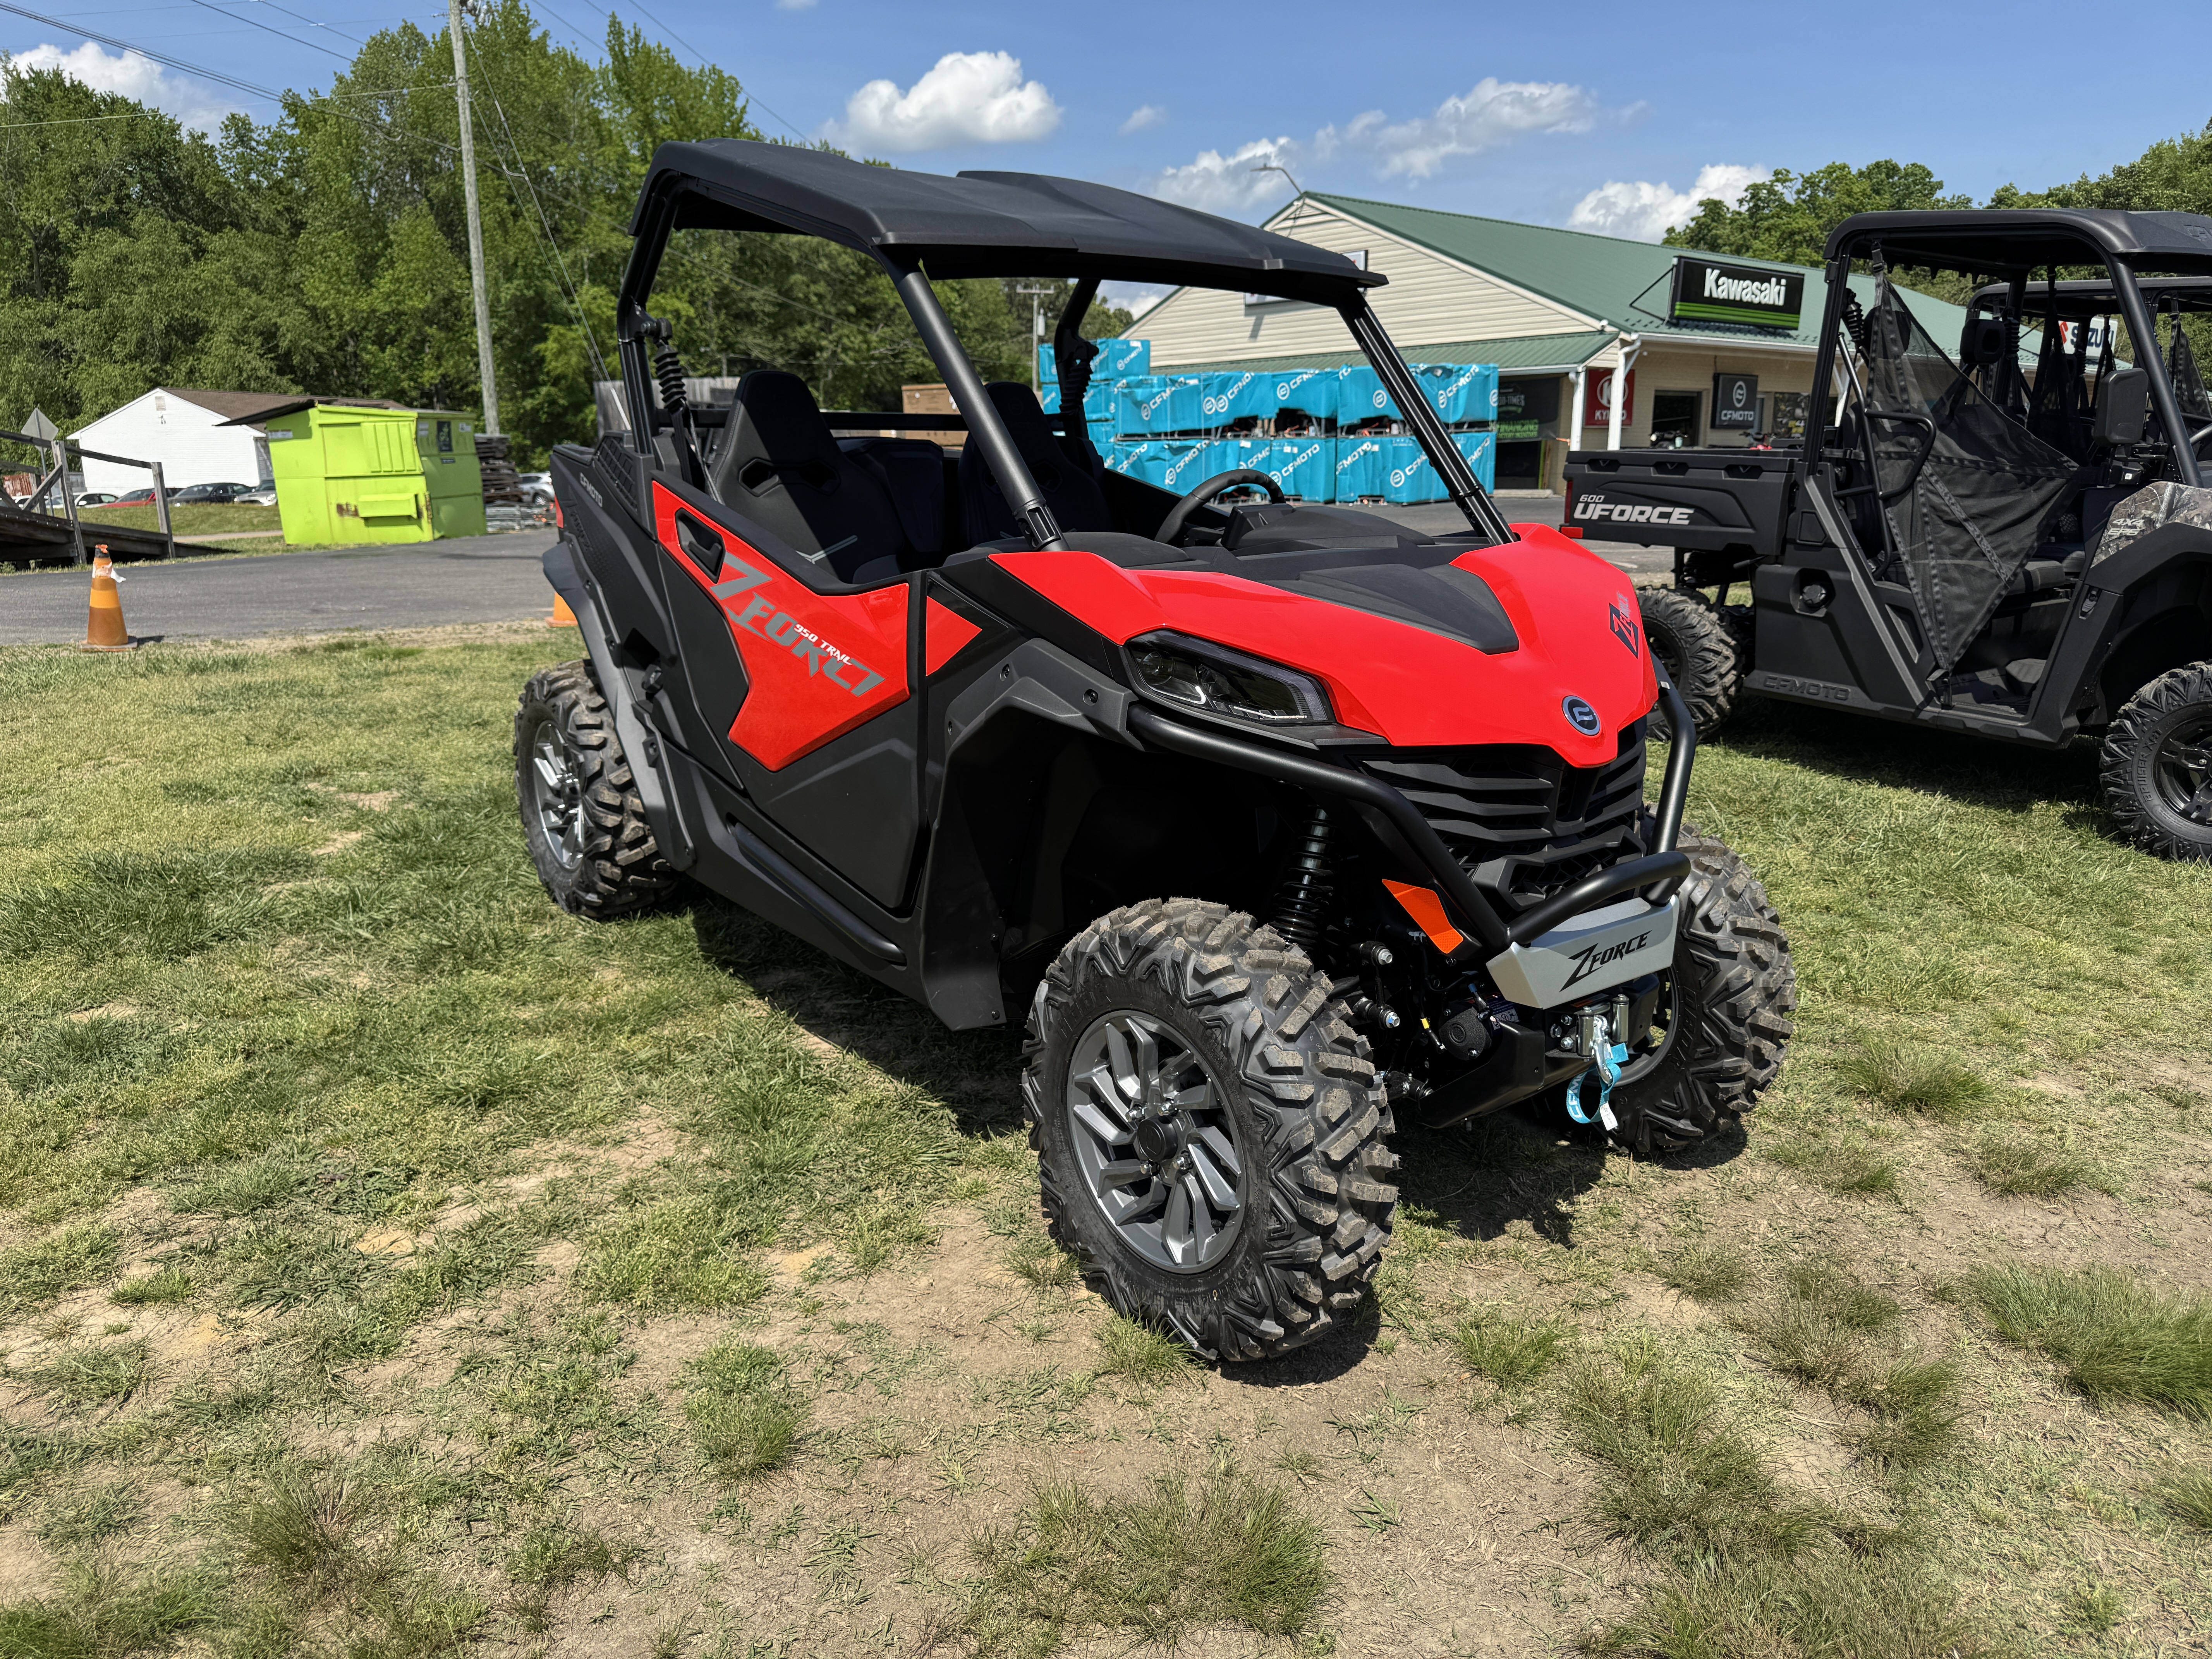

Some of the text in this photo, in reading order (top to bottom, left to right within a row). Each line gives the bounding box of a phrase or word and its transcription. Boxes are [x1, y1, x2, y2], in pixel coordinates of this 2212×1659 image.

[1704, 268, 1786, 306] Kawasaki
[2070, 325, 2115, 349] SZUI
[1595, 409, 1627, 421] KYO
[1721, 410, 1754, 421] CFMOTO
[1281, 443, 1320, 477] CFMOTO
[580, 472, 603, 508] CFMOTO
[1580, 494, 1605, 503] 600
[1573, 503, 1695, 525] UFORCE
[2112, 518, 2145, 529] 4X4
[794, 623, 852, 666] 950 TRAIL
[1764, 675, 1851, 701] CFMOTO
[1559, 930, 1652, 992] ZFORCE
